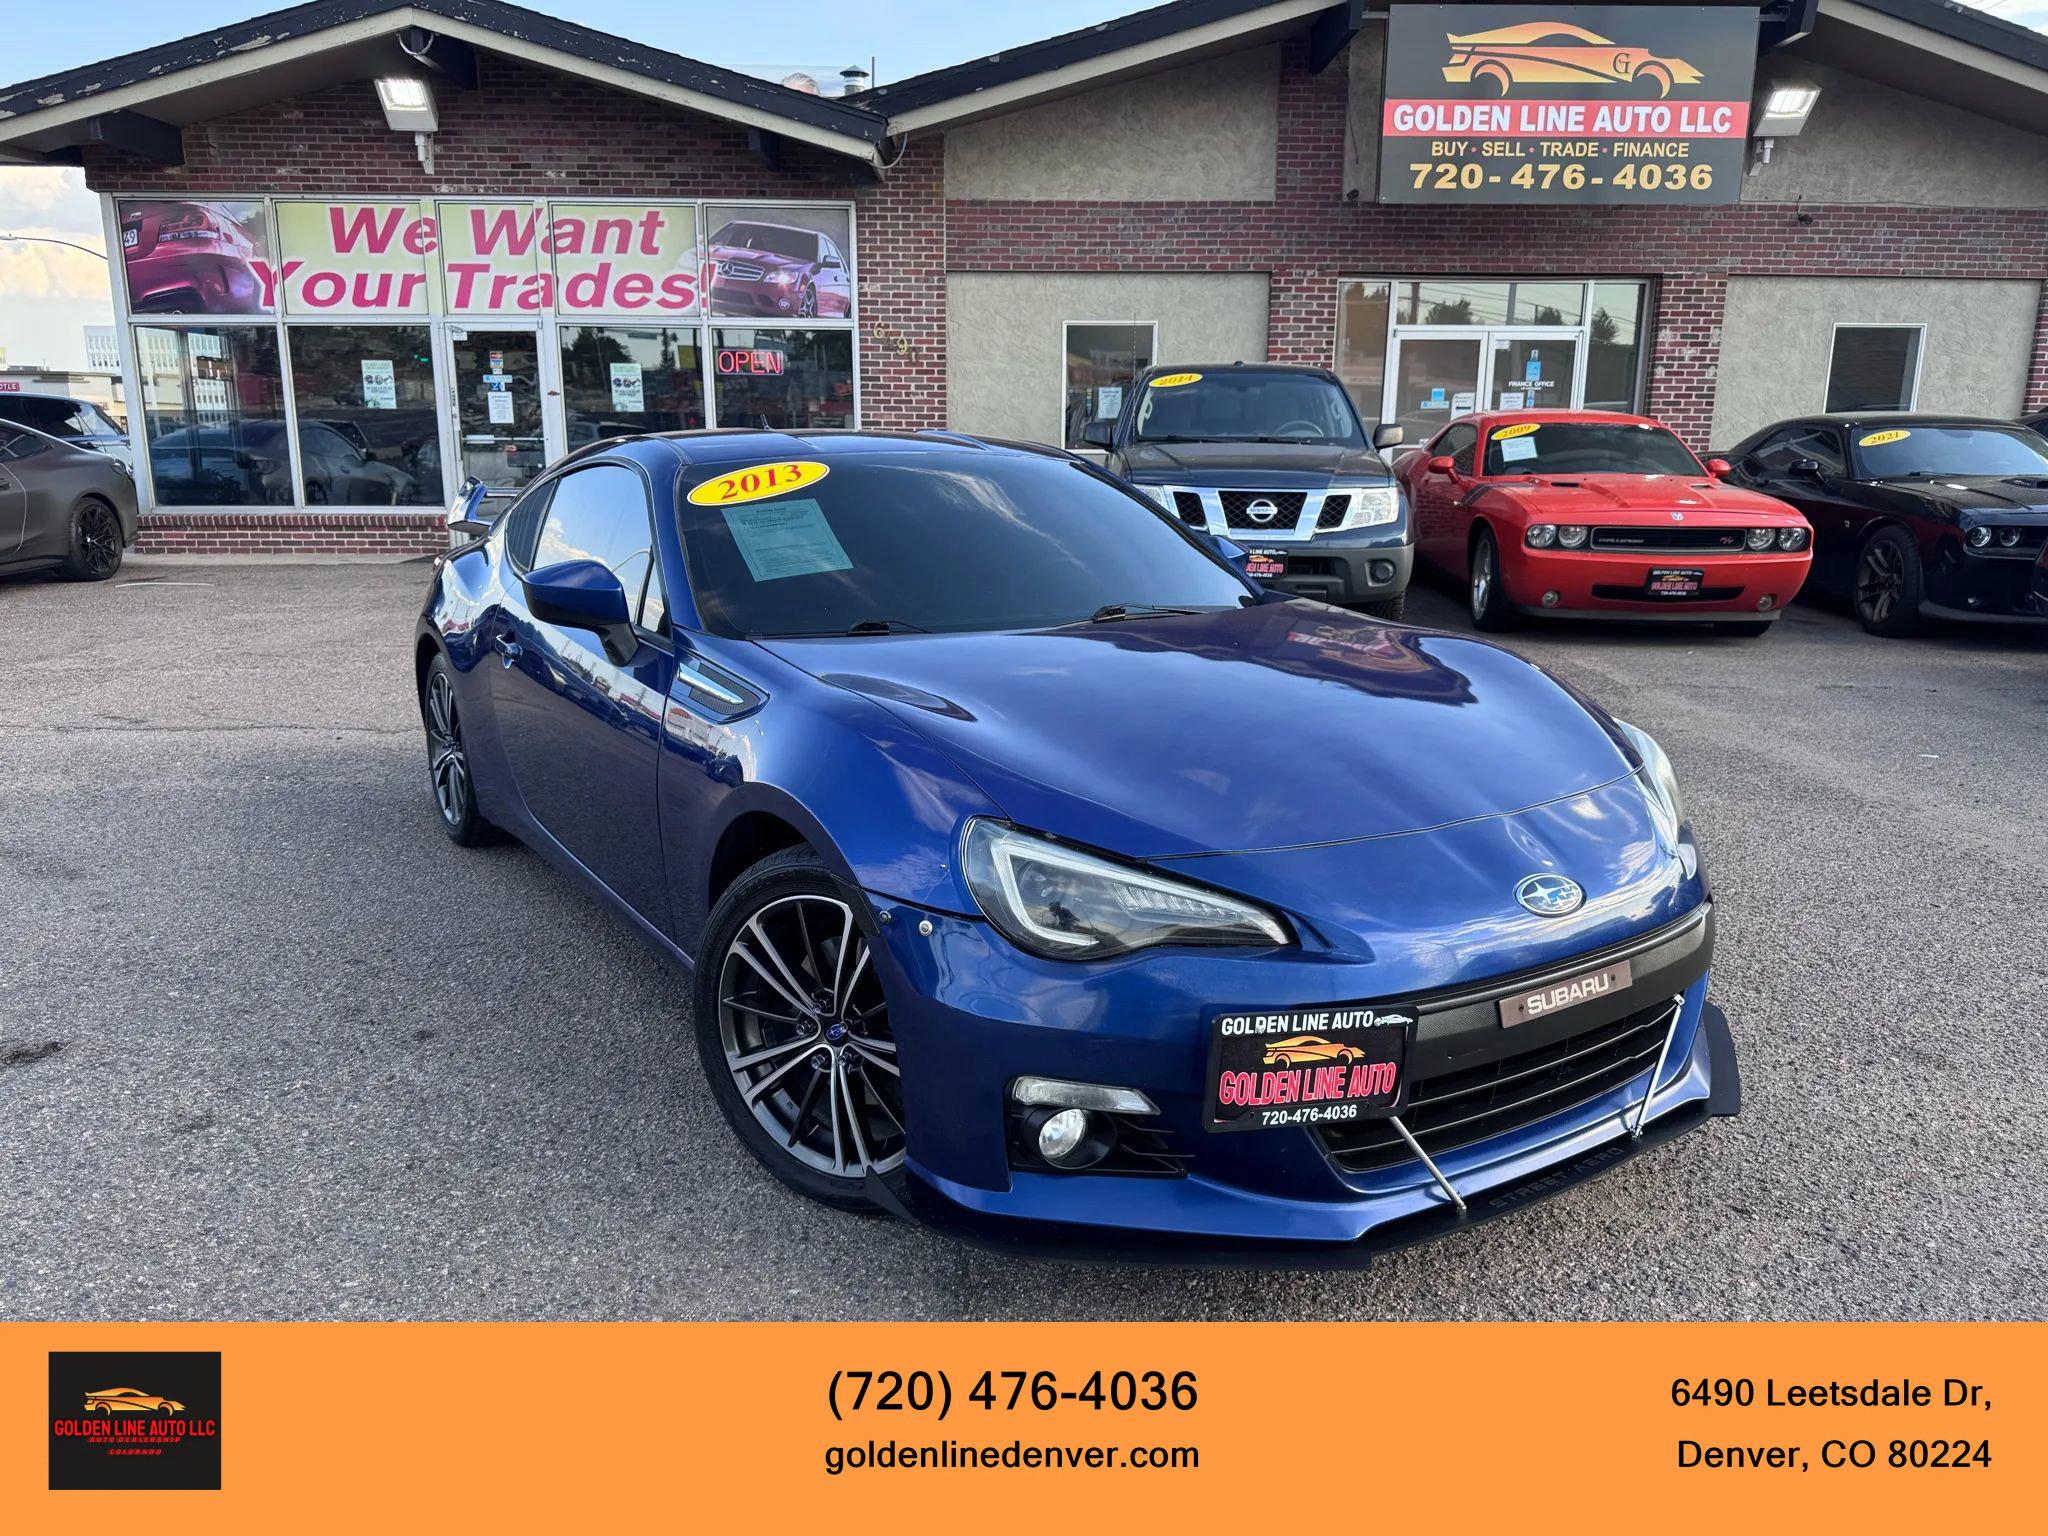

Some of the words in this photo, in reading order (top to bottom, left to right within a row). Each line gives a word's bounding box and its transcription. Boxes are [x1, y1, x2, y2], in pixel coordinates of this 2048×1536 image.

[1393, 104, 1511, 132] GOLDEN
[1519, 105, 1586, 133] LINE
[1592, 105, 1671, 133] AUTO
[1679, 106, 1732, 133] LLC
[1431, 141, 1469, 157] BUY
[1481, 141, 1526, 157] SELL
[1540, 141, 1599, 157] TRADE
[1613, 142, 1690, 158] FINANCE
[329, 207, 438, 255] We
[470, 207, 665, 256] Want
[248, 260, 427, 308] Your
[447, 262, 718, 310] Trades!
[719, 351, 783, 374] OPEN
[1871, 431, 1900, 444] 2021
[718, 464, 802, 501] 2013
[1527, 973, 1609, 1015] SUBARU
[1221, 1014, 1289, 1036] GOLDEN
[1292, 1013, 1328, 1032] LINE
[1331, 1011, 1374, 1030] AUTO
[1219, 1070, 1301, 1106] GOLDEN
[1302, 1066, 1346, 1101] LINE
[1347, 1061, 1397, 1098] AUTO
[1262, 1104, 1357, 1125] 720-476-4036
